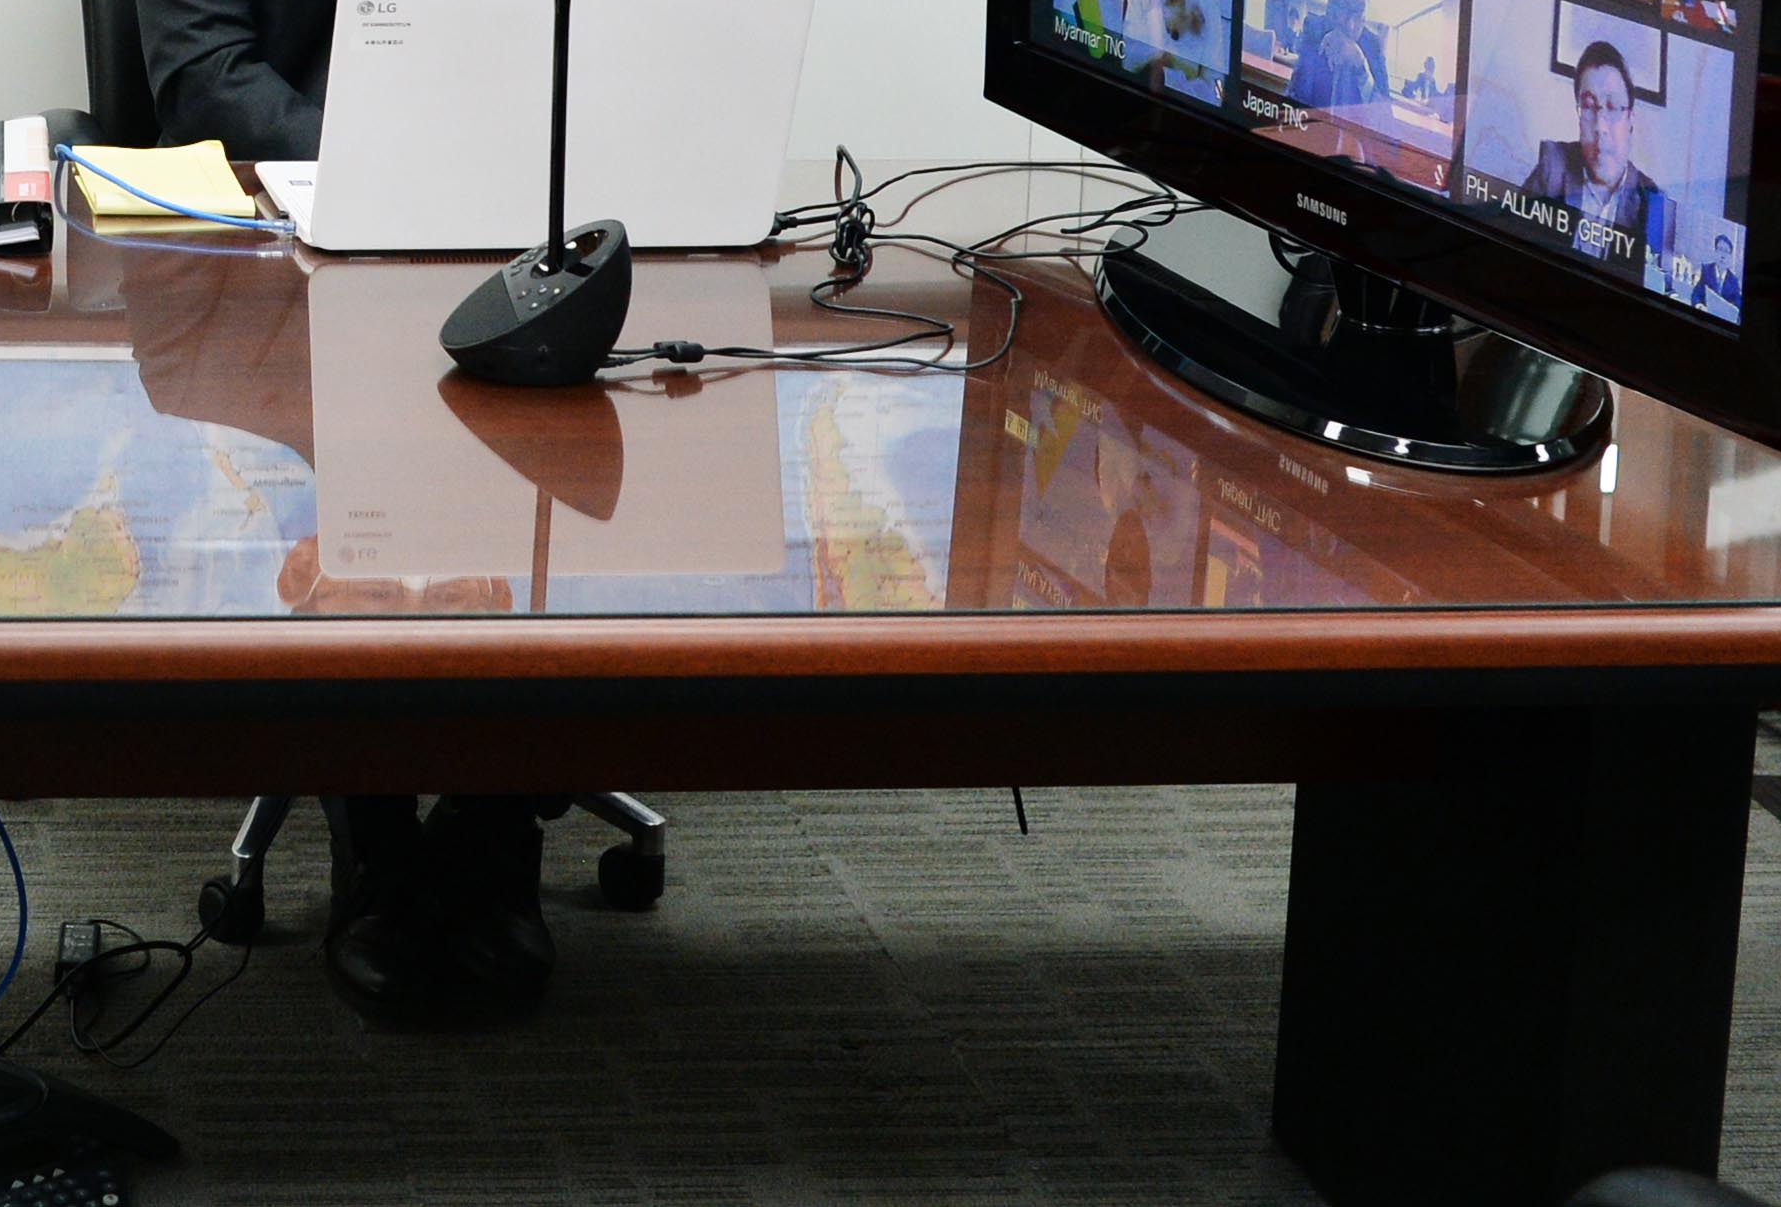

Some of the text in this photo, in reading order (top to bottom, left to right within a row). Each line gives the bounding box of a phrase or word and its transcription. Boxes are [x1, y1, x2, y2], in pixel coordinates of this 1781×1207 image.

[378, 2, 397, 14] LG
[1054, 17, 1127, 60] Myanmar TNC
[1243, 89, 1308, 131] Japan TNC
[1296, 192, 1348, 226] SAMSUNG
[1466, 174, 1489, 202] PH
[1501, 188, 1554, 226] ALLAN
[1556, 210, 1573, 237] B.
[1578, 218, 1636, 258] GEPTY
